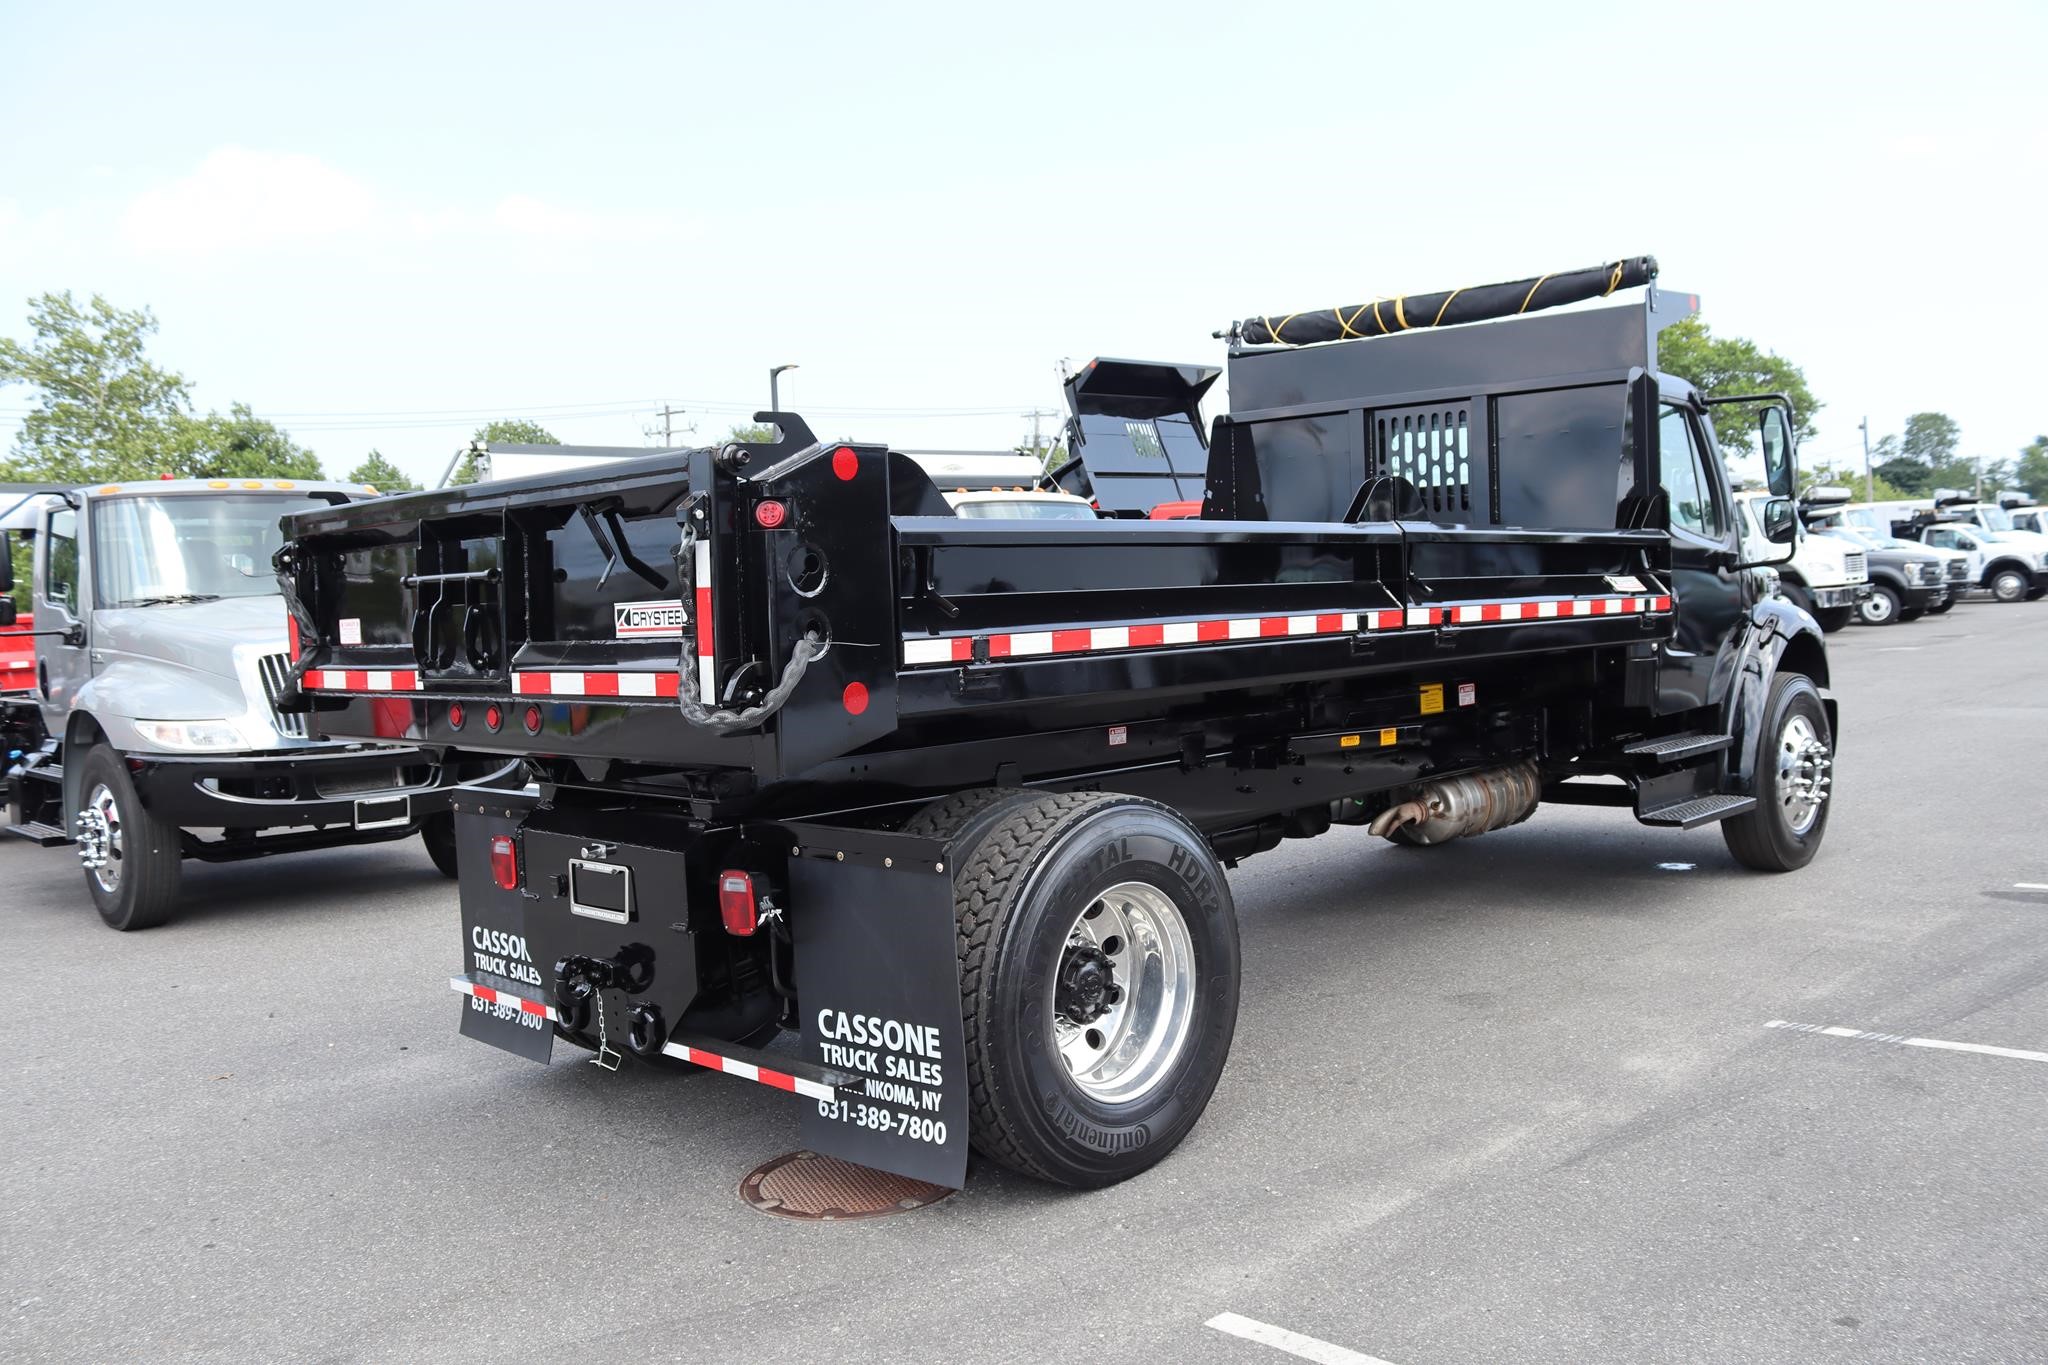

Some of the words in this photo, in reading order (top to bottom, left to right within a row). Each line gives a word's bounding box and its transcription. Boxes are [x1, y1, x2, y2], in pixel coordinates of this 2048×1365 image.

[632, 609, 687, 627] CRYSTEEL
[1167, 844, 1219, 914] HDR2
[472, 925, 532, 963] CASSON
[473, 951, 507, 977] TRUCK
[509, 962, 542, 986] SALES
[471, 996, 543, 1031] 631-389-7800
[817, 1008, 942, 1060] CASSONE
[819, 1042, 879, 1074] TRUCK
[885, 1055, 943, 1086] SALES
[922, 1090, 942, 1112] NY
[818, 1098, 947, 1145] 631-389-7800
